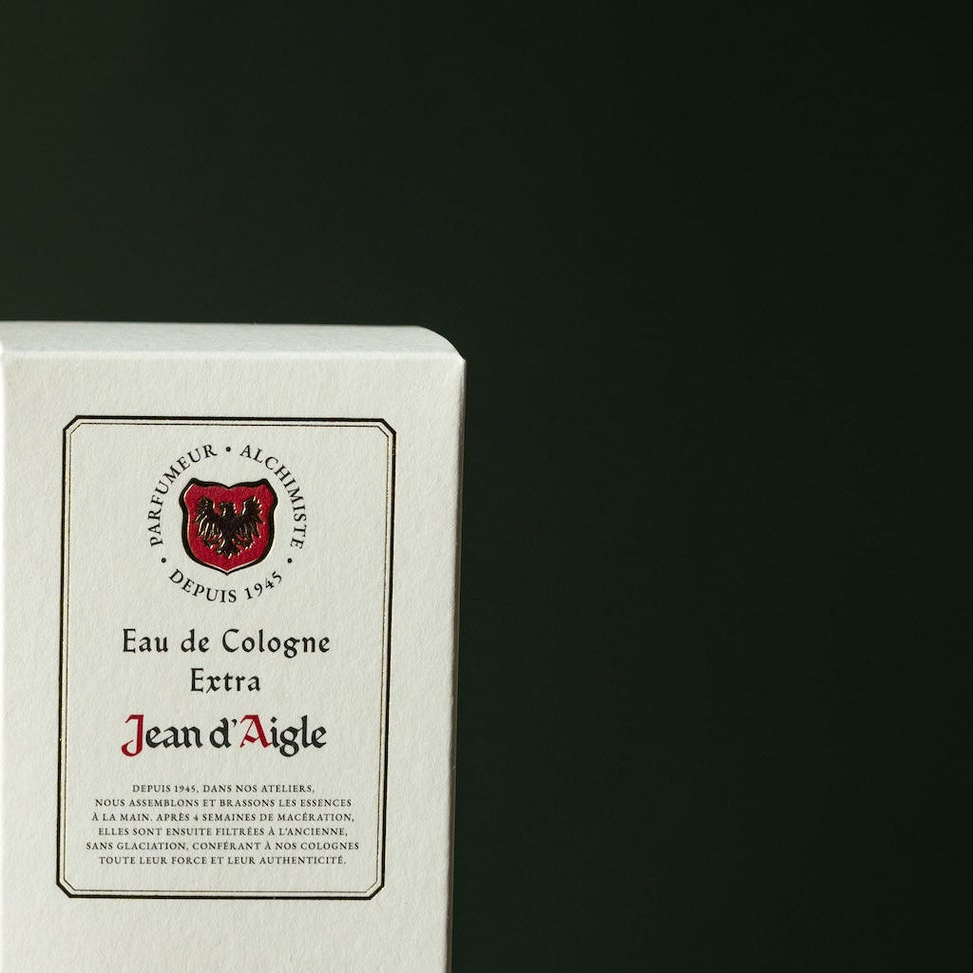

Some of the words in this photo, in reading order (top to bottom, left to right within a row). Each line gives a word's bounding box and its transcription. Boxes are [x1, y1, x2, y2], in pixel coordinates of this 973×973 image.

[147, 444, 217, 547] PARFUMEUR
[240, 444, 307, 550] ALCHIMISTE
[169, 569, 237, 602] DEPUIS
[245, 572, 282, 599] 1945
[123, 629, 168, 653] Eau
[181, 629, 210, 652] de
[222, 629, 330, 658] Cologne
[190, 668, 261, 693] Extra
[121, 715, 202, 756] Jean
[133, 785, 171, 793] DEPUIS
[175, 785, 199, 794] 1945,
[203, 785, 232, 793] DANS
[236, 785, 258, 793] NOS
[261, 785, 315, 794] ATELIERS,
[95, 799, 125, 807] NOUS
[129, 799, 199, 807] ASSEMBLONS
[203, 799, 216, 807] ET
[220, 799, 275, 807] BRASSONS
[279, 799, 296, 807] LES
[300, 799, 352, 807] ESSENCES
[92, 812, 99, 821] À
[103, 813, 116, 821] LA
[120, 813, 152, 821] MAIN.
[156, 812, 190, 821] APRÈS
[193, 813, 199, 822] 4
[202, 813, 256, 821] SEMAINES
[260, 813, 274, 821] DE
[277, 812, 354, 822] MACÉRATION,
[99, 828, 129, 836] ELLES
[133, 828, 162, 836] SONT
[166, 828, 212, 836] ENSUITE
[216, 826, 264, 836] FILTRÉES
[268, 826, 275, 836] À
[279, 828, 348, 837] L'ANCIENNE,
[86, 842, 113, 850] SANS
[117, 842, 188, 851] GLACIATION,
[192, 841, 261, 850] CONFÉRANT
[264, 841, 271, 850] À
[275, 842, 297, 850] NOS
[301, 842, 359, 850] COLOGNES
[99, 856, 135, 864] TOUTE
[139, 856, 167, 864] LEUR
[171, 856, 207, 864] FORCE
[211, 856, 224, 864] ET
[228, 856, 255, 864] LEUR
[259, 855, 346, 864] AUTHENTICITÉ.
